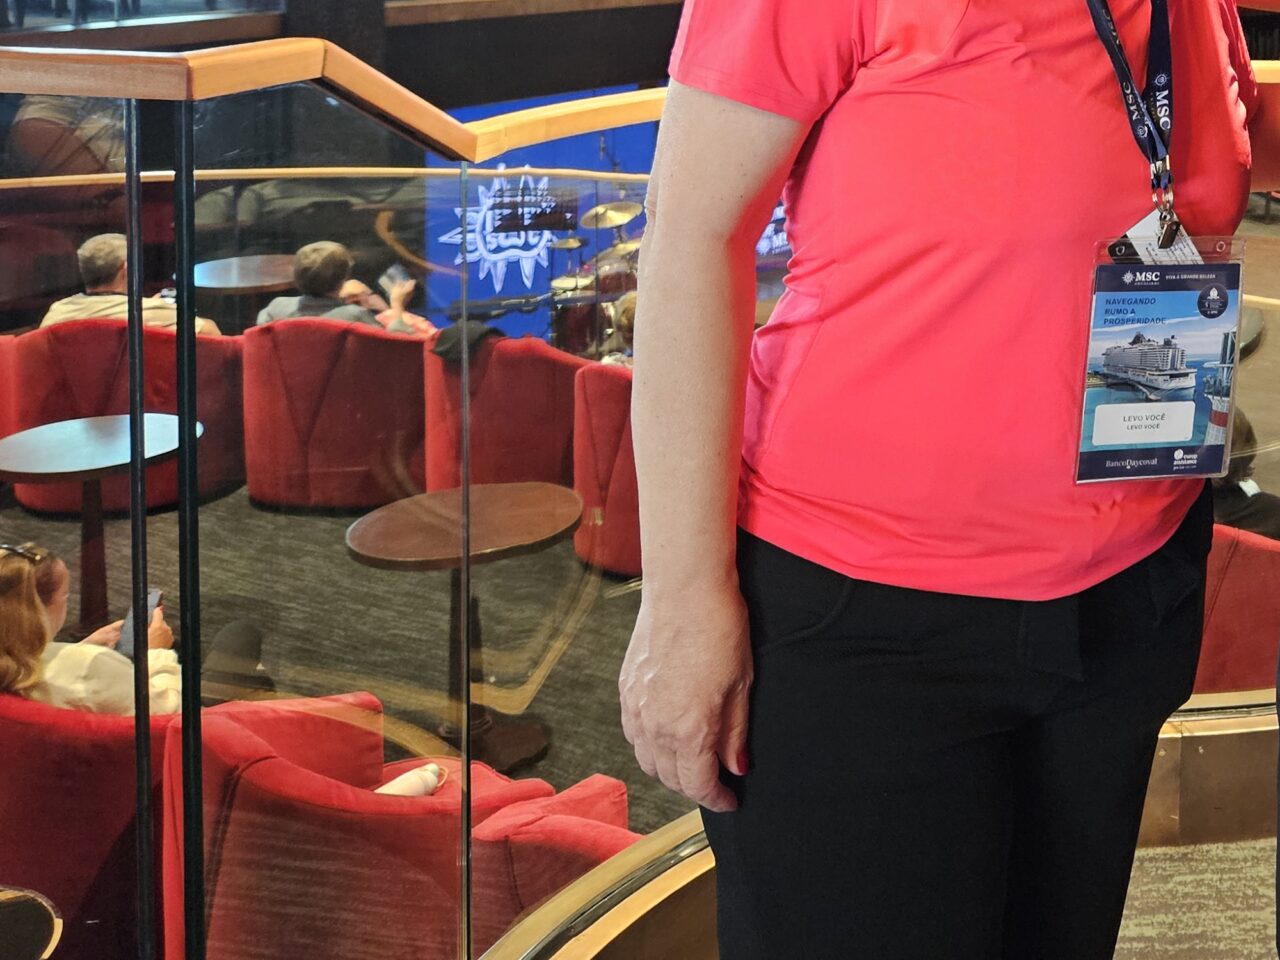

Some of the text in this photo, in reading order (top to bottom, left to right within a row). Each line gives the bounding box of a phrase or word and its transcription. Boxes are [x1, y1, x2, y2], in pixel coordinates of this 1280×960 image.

[1123, 81, 1140, 120] MSC
[1156, 90, 1171, 131] MSC
[1134, 272, 1160, 282] MSC
[1105, 297, 1157, 305] NAVEGANDO
[1104, 308, 1128, 316] RUMO
[1103, 318, 1166, 326] PROSPERIDADE
[1145, 413, 1166, 421] VOCÊ
